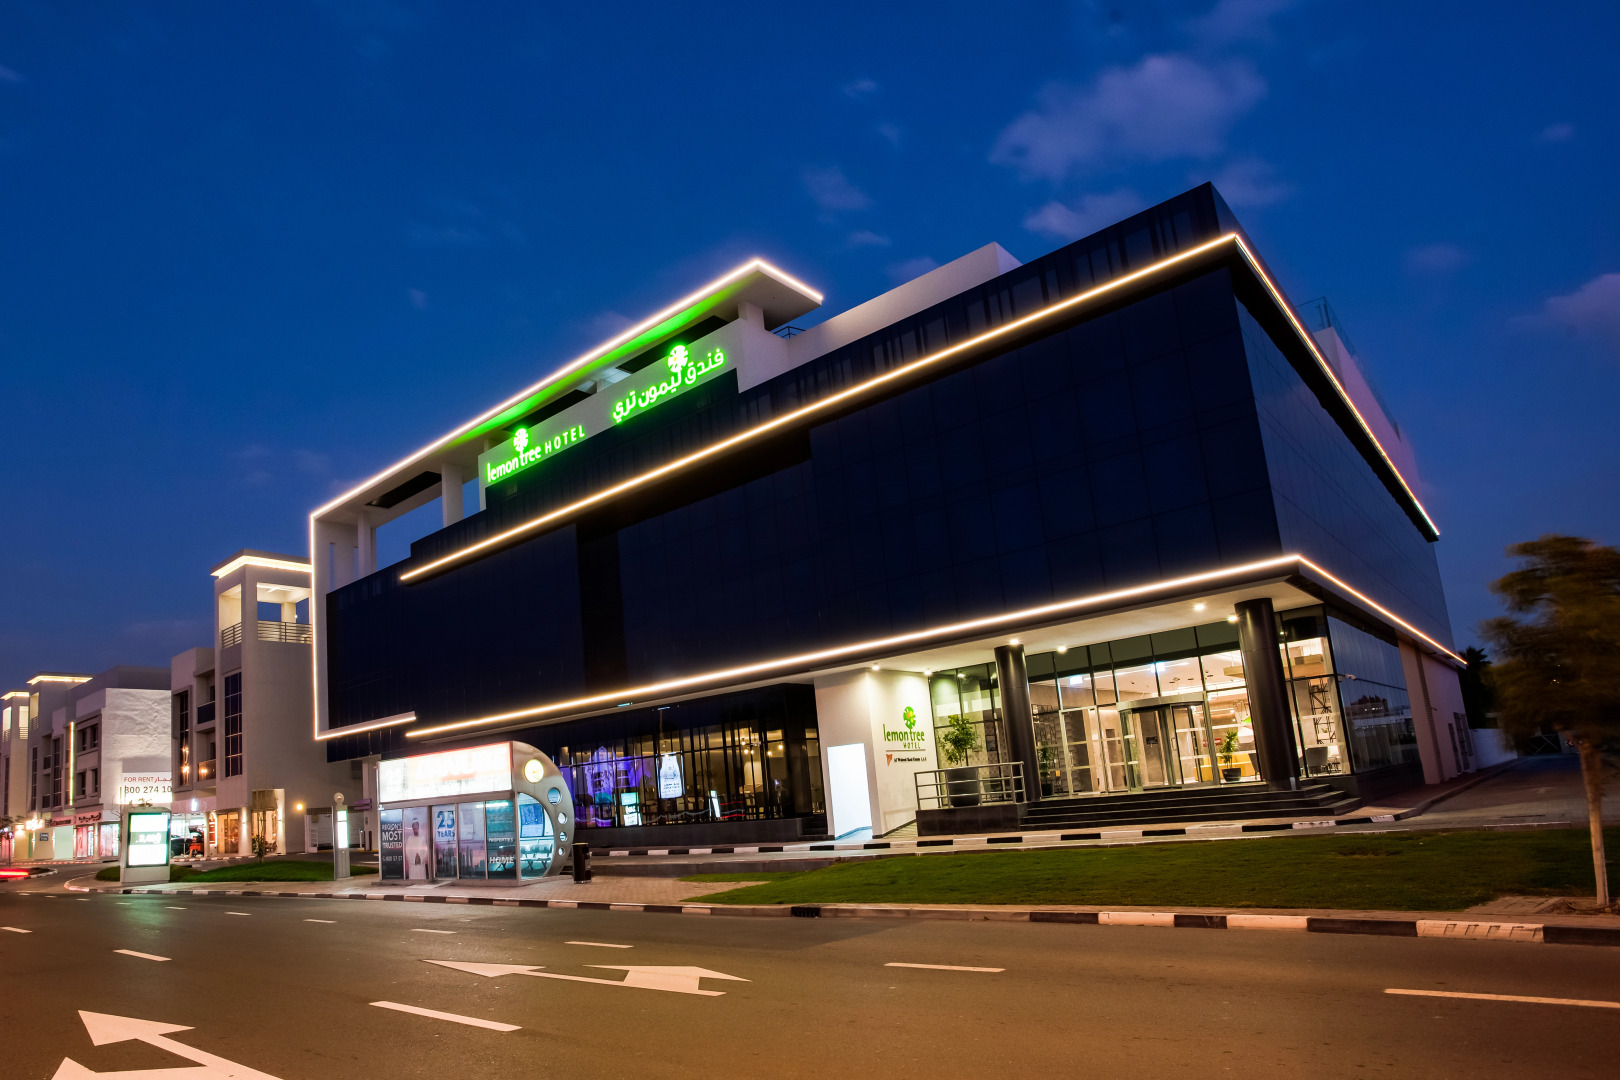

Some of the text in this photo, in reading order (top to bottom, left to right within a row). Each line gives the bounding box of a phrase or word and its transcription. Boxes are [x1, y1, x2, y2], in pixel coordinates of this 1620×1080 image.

[612, 348, 725, 423] فندق ليمون تري
[544, 424, 585, 454] HOTEL
[143, 785, 159, 794] 274
[436, 811, 455, 829] 25
[382, 831, 402, 841] MOST
[436, 830, 456, 838] YEARS
[382, 841, 403, 849] TRUSTED
[489, 856, 514, 864] HOME
